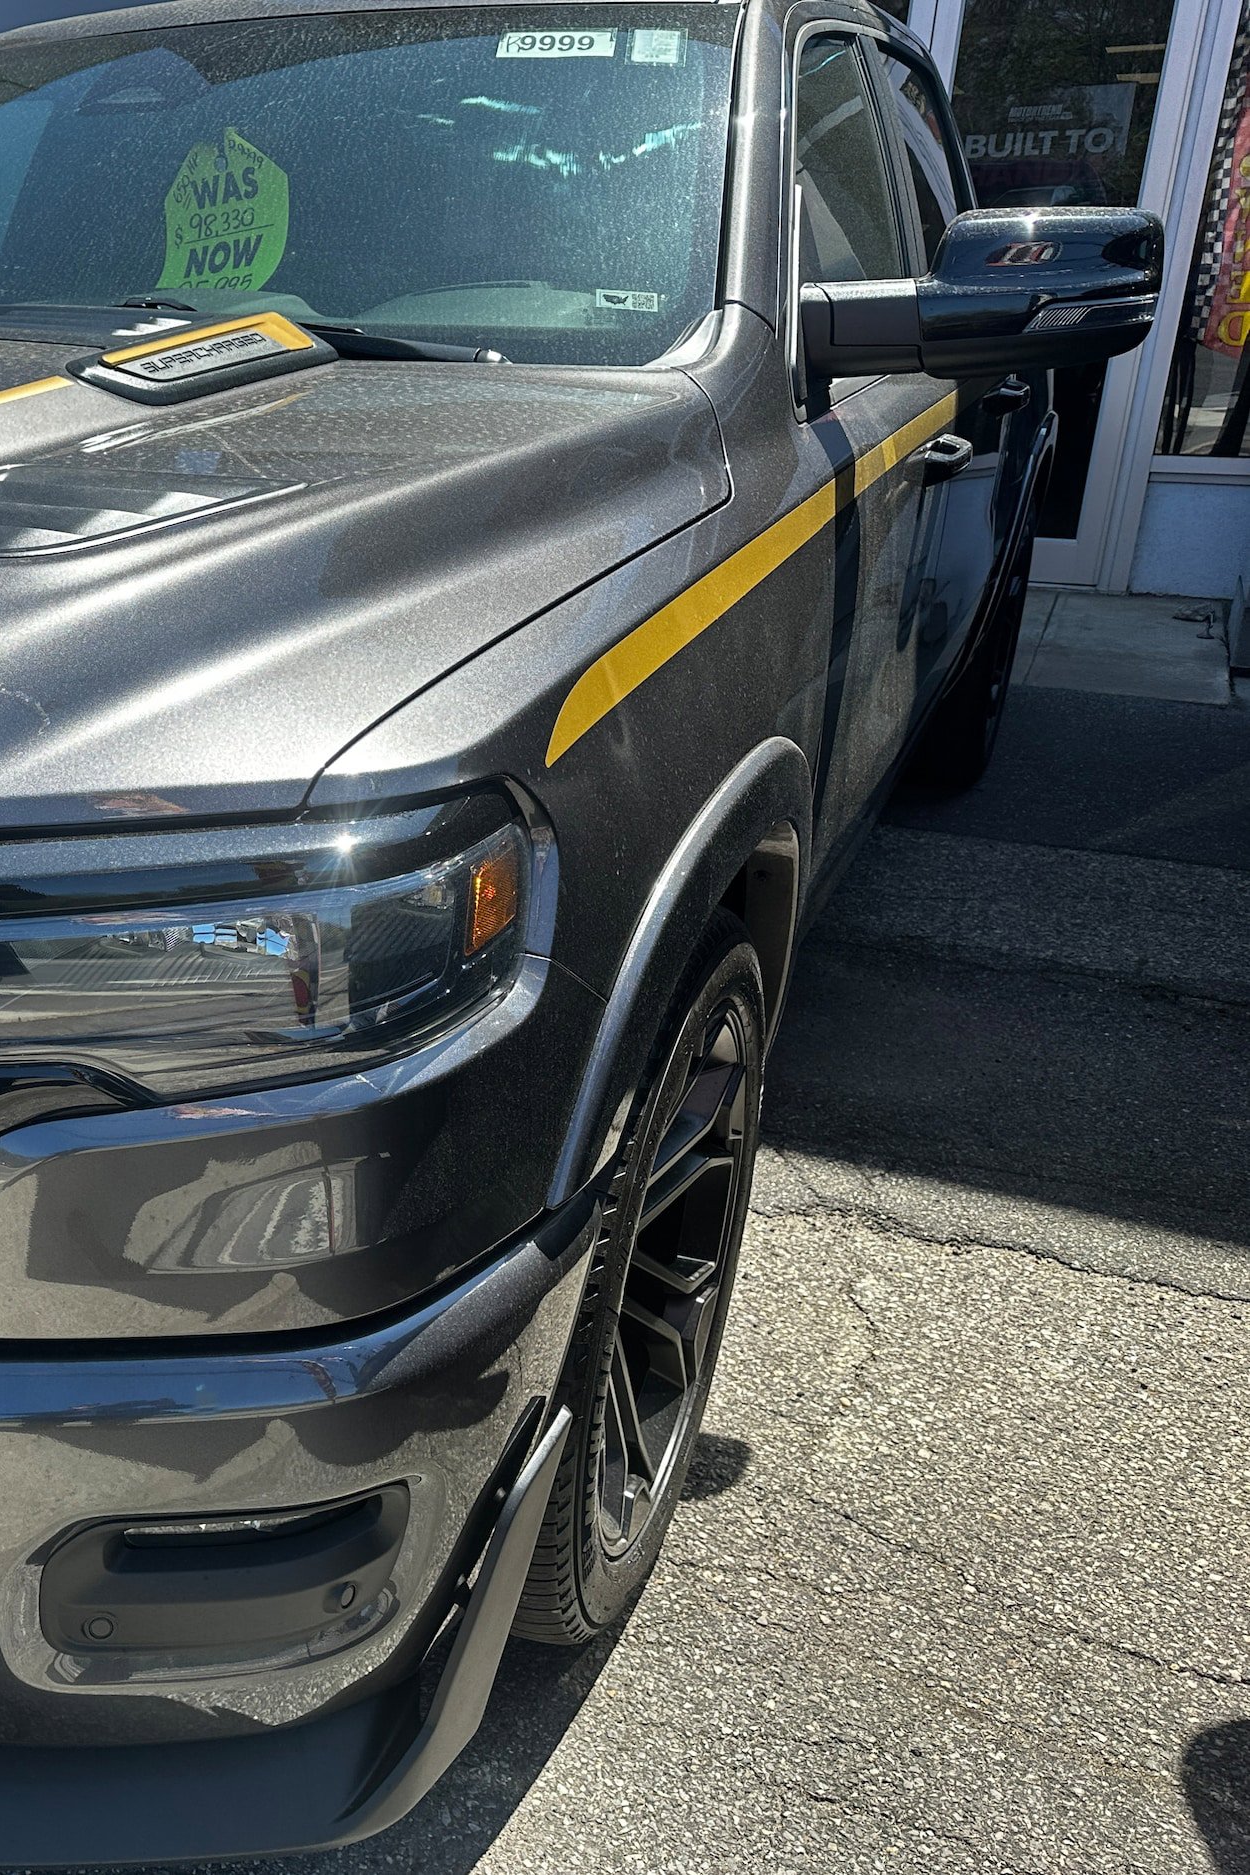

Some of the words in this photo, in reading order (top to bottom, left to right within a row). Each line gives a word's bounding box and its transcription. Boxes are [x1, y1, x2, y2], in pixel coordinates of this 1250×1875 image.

[964, 130, 1059, 159] BUILT
[1065, 127, 1115, 154] TO
[191, 166, 259, 210] WAS
[183, 233, 264, 279] NOW
[140, 332, 267, 374] SUPERCHARGED
